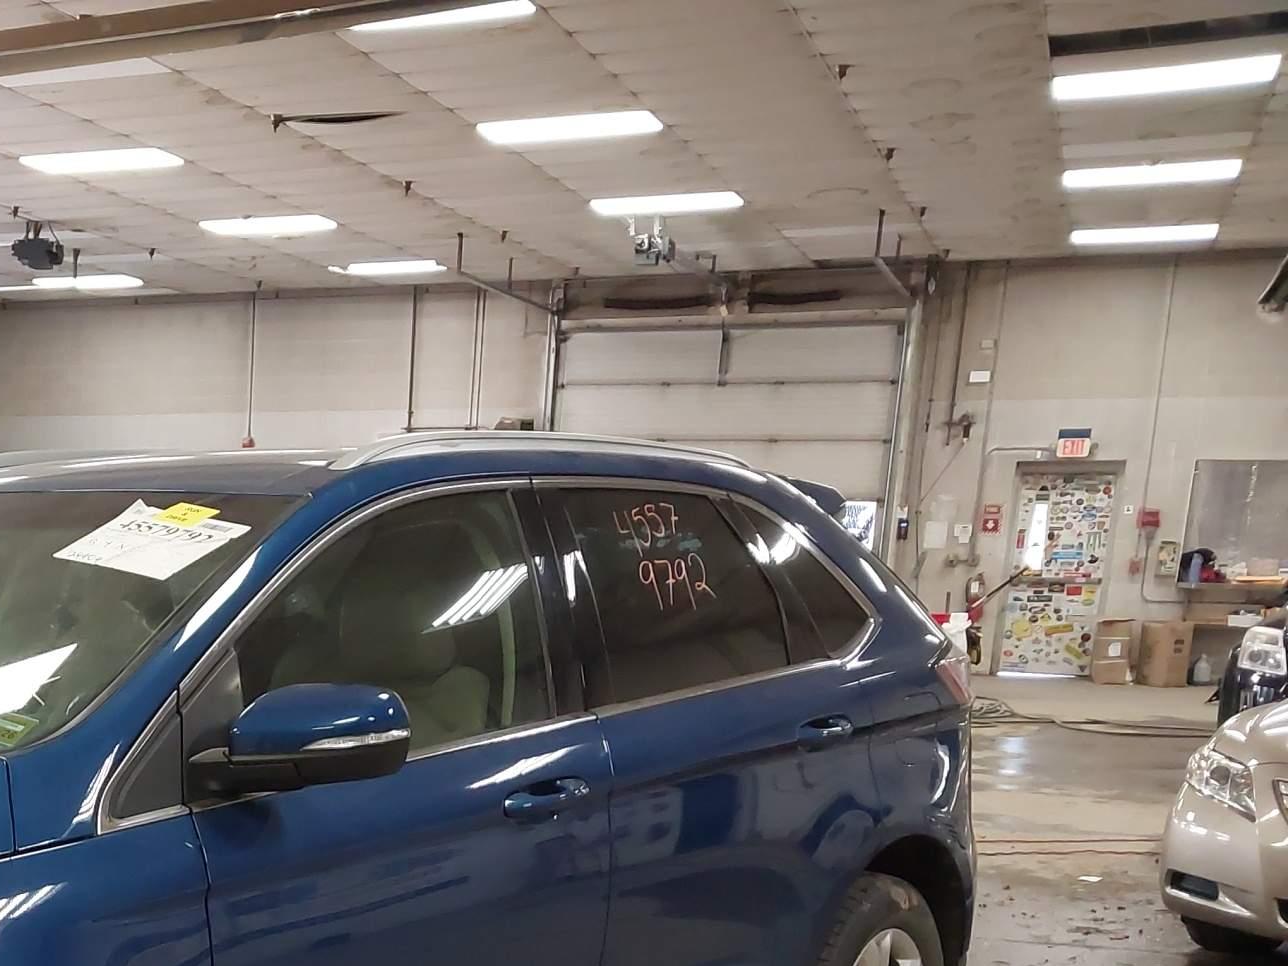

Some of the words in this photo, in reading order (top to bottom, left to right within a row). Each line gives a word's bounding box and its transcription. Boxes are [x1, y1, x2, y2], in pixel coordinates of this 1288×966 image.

[1063, 439, 1085, 456] EXIT
[119, 518, 215, 544] 45579792
[613, 502, 679, 558] 4557
[638, 552, 718, 612] 9792
